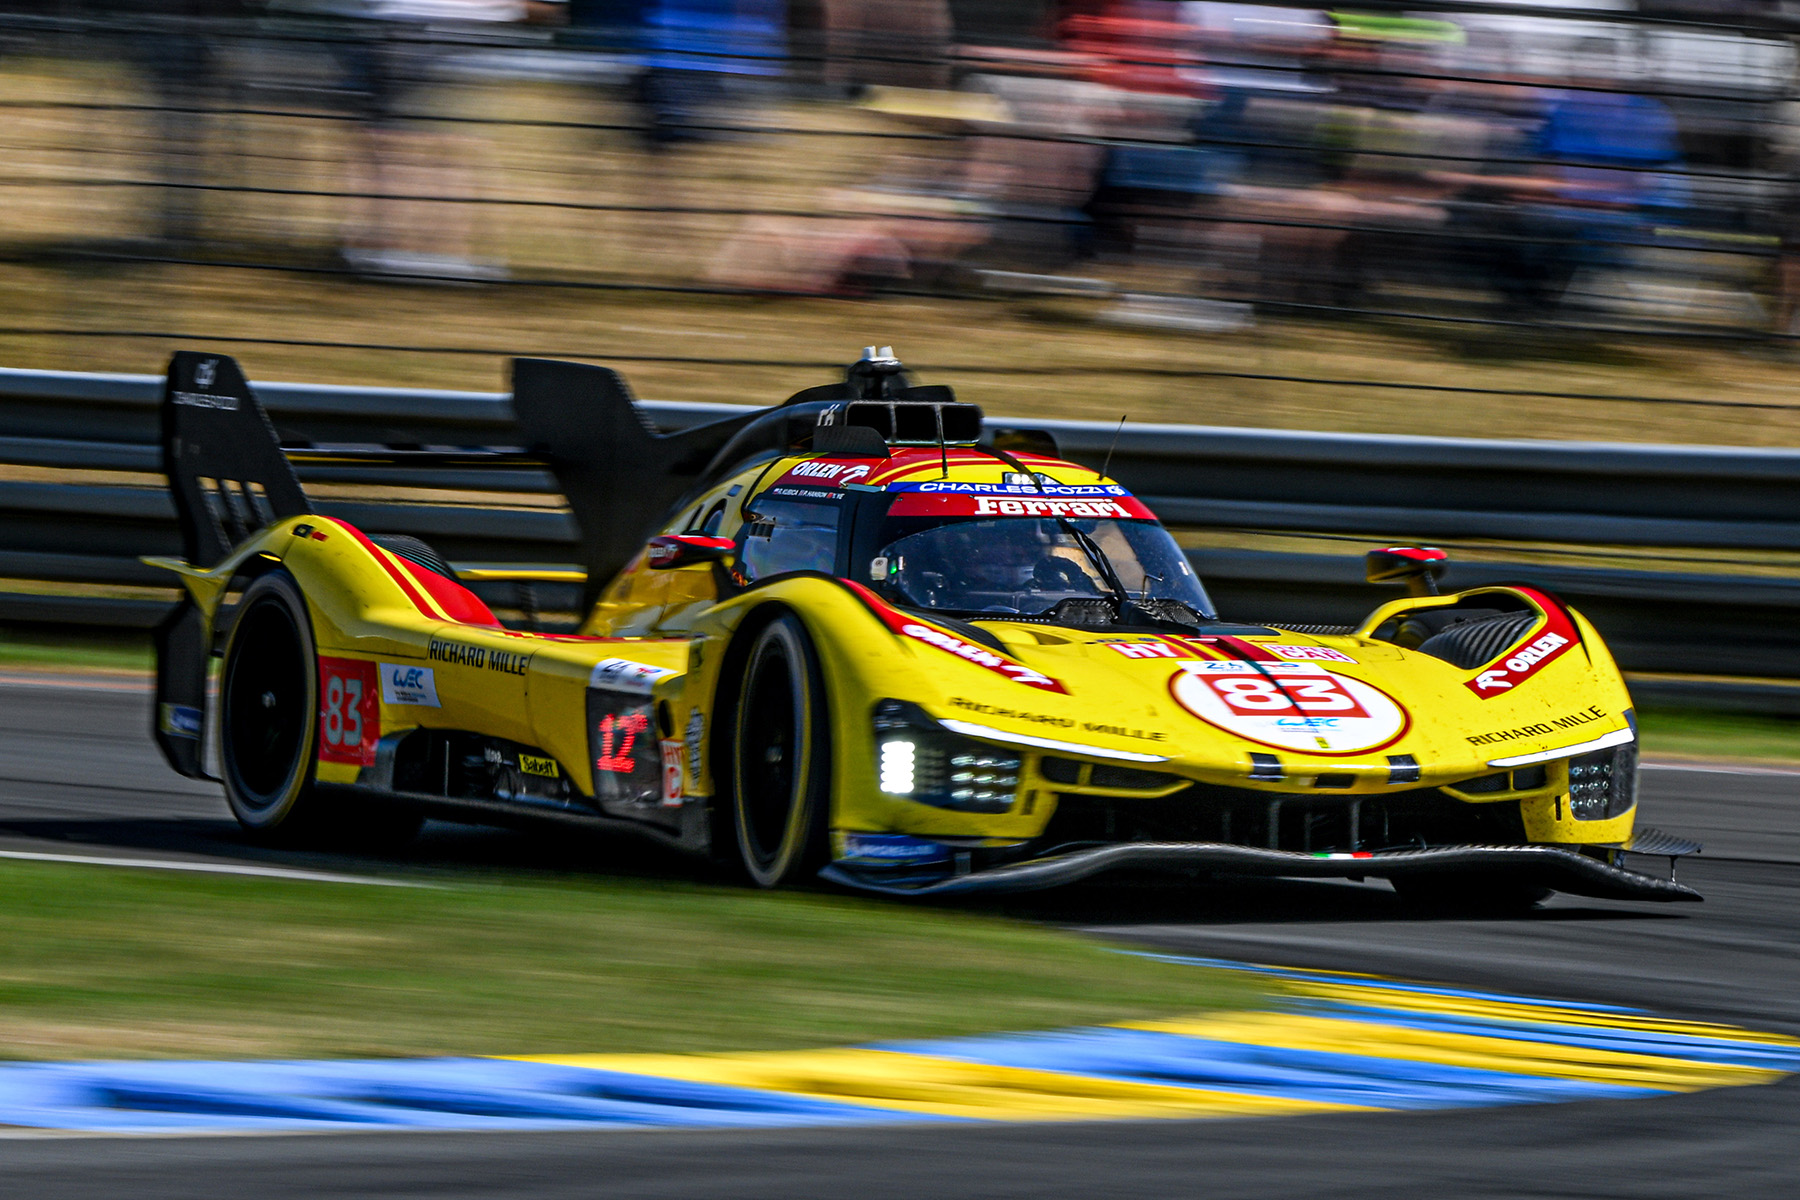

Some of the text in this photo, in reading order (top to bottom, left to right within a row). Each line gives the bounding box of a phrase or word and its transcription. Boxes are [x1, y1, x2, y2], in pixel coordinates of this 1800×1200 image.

[792, 462, 844, 479] ORLEN
[919, 483, 1104, 495] CHARLES POZZI
[974, 496, 1132, 518] Ferrari
[429, 640, 528, 676] RICHARD MILLE
[902, 624, 1004, 667] ORLEN
[1108, 643, 1178, 658] HY
[1505, 632, 1569, 672] ORLEN
[393, 668, 423, 689] WEC
[1213, 678, 1355, 711] 83
[326, 676, 363, 746] 83
[950, 697, 1168, 742] RICHARD MILLE
[1465, 705, 1607, 746] RICHARD MILLE
